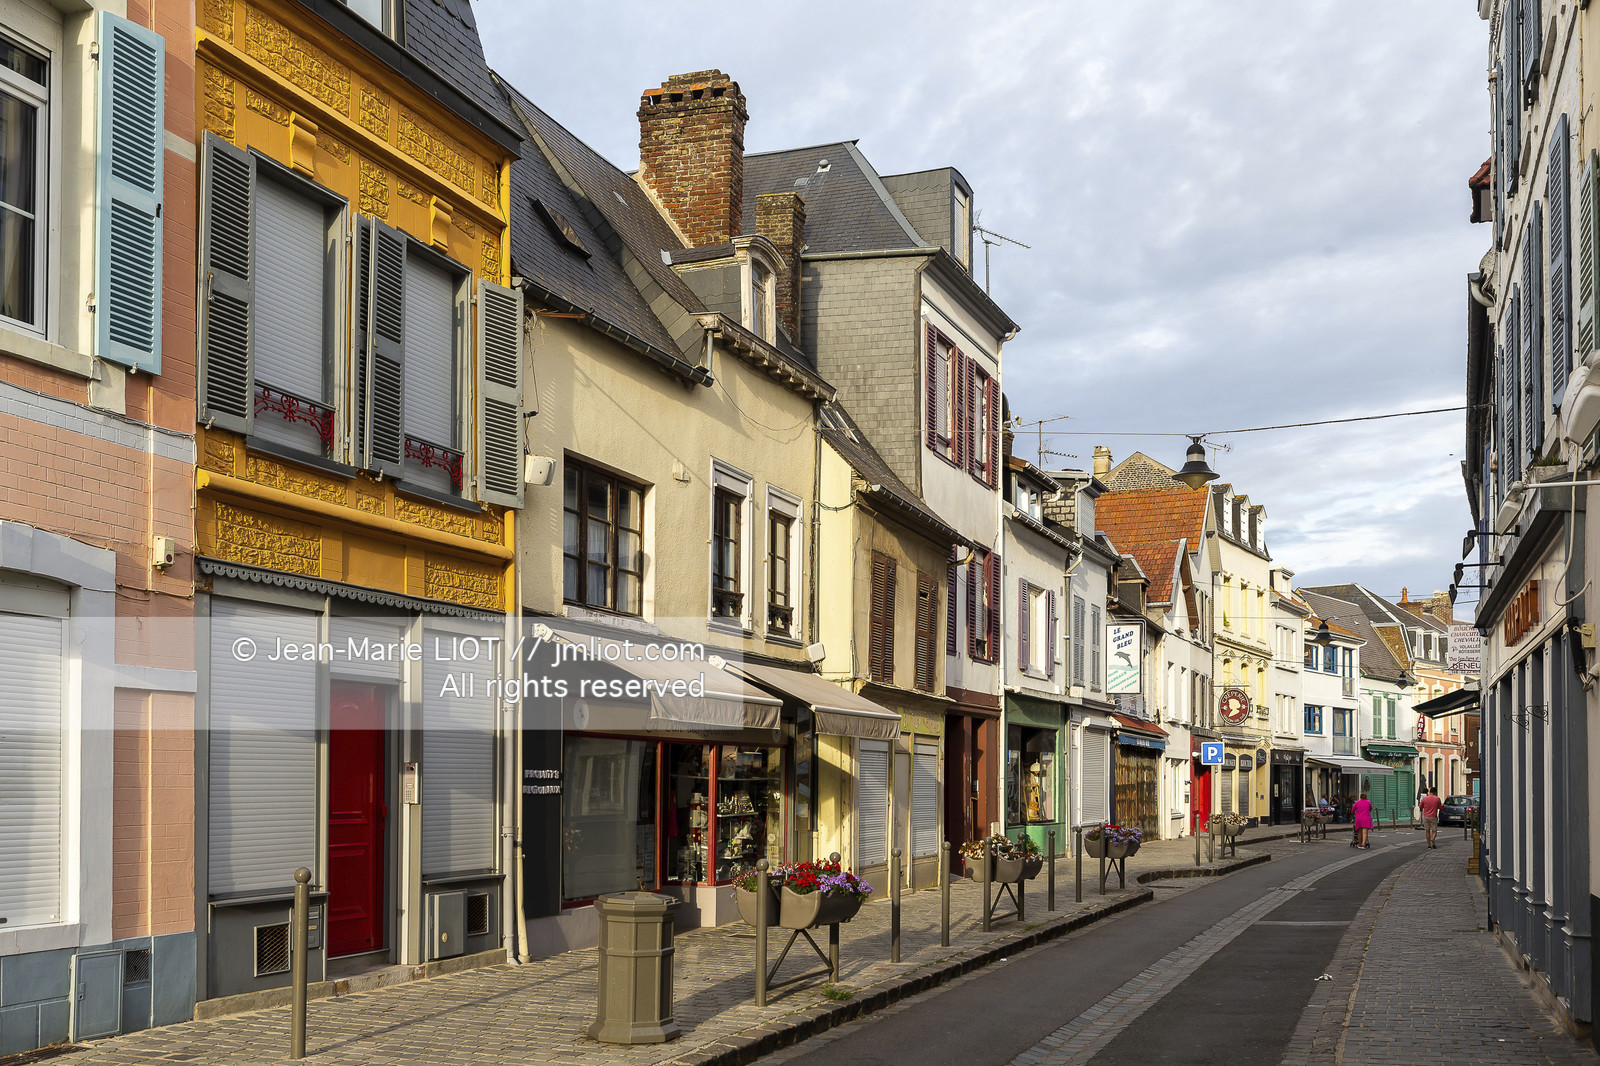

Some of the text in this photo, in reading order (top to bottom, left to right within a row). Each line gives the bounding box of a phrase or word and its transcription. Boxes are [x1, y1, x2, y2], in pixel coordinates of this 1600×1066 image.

[1112, 630, 1134, 643] GRAND
[1113, 627, 1121, 635] LE
[1117, 639, 1133, 650] BLEU
[1207, 747, 1218, 761] P
[524, 769, 560, 779] PRODUITS
